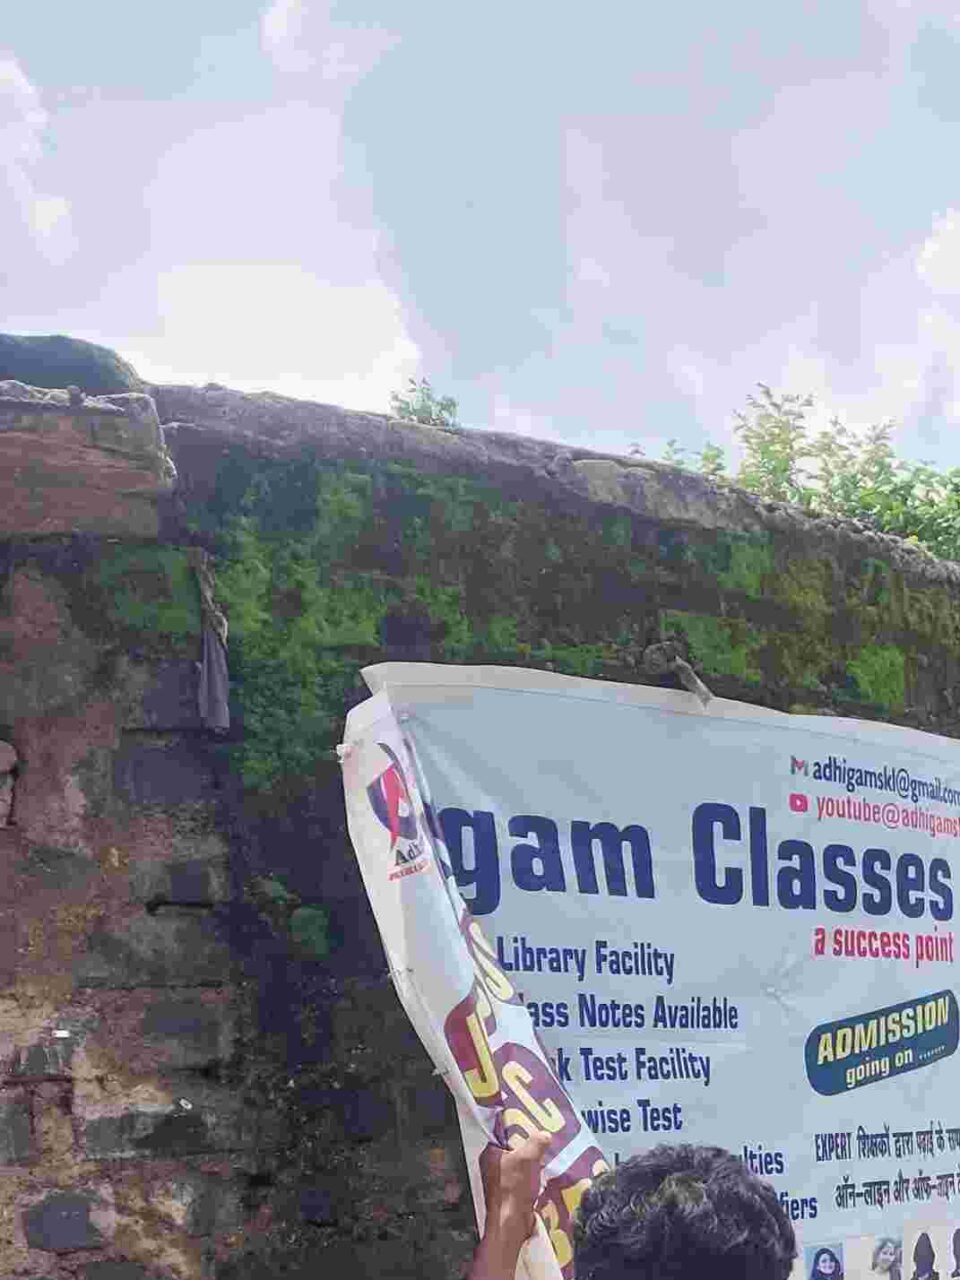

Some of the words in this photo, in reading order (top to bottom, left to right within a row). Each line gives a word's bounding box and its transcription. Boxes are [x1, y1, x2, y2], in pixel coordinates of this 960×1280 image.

[692, 802, 954, 921] Classes
[497, 936, 586, 982] Library
[595, 940, 675, 984] Facility
[814, 927, 826, 956] a
[832, 926, 910, 959] success
[916, 925, 954, 968] point
[525, 1000, 569, 1028] ass
[578, 993, 645, 1028] Notes
[652, 995, 738, 1029] Available
[817, 996, 950, 1065] ADMISSION
[579, 1047, 628, 1082] Test
[635, 1047, 711, 1087] Facility
[846, 1056, 890, 1089] going
[895, 1047, 913, 1068] on
[637, 1098, 683, 1132] Test
[815, 1132, 852, 1162] EXPERT
[893, 1130, 914, 1160] द्वारा
